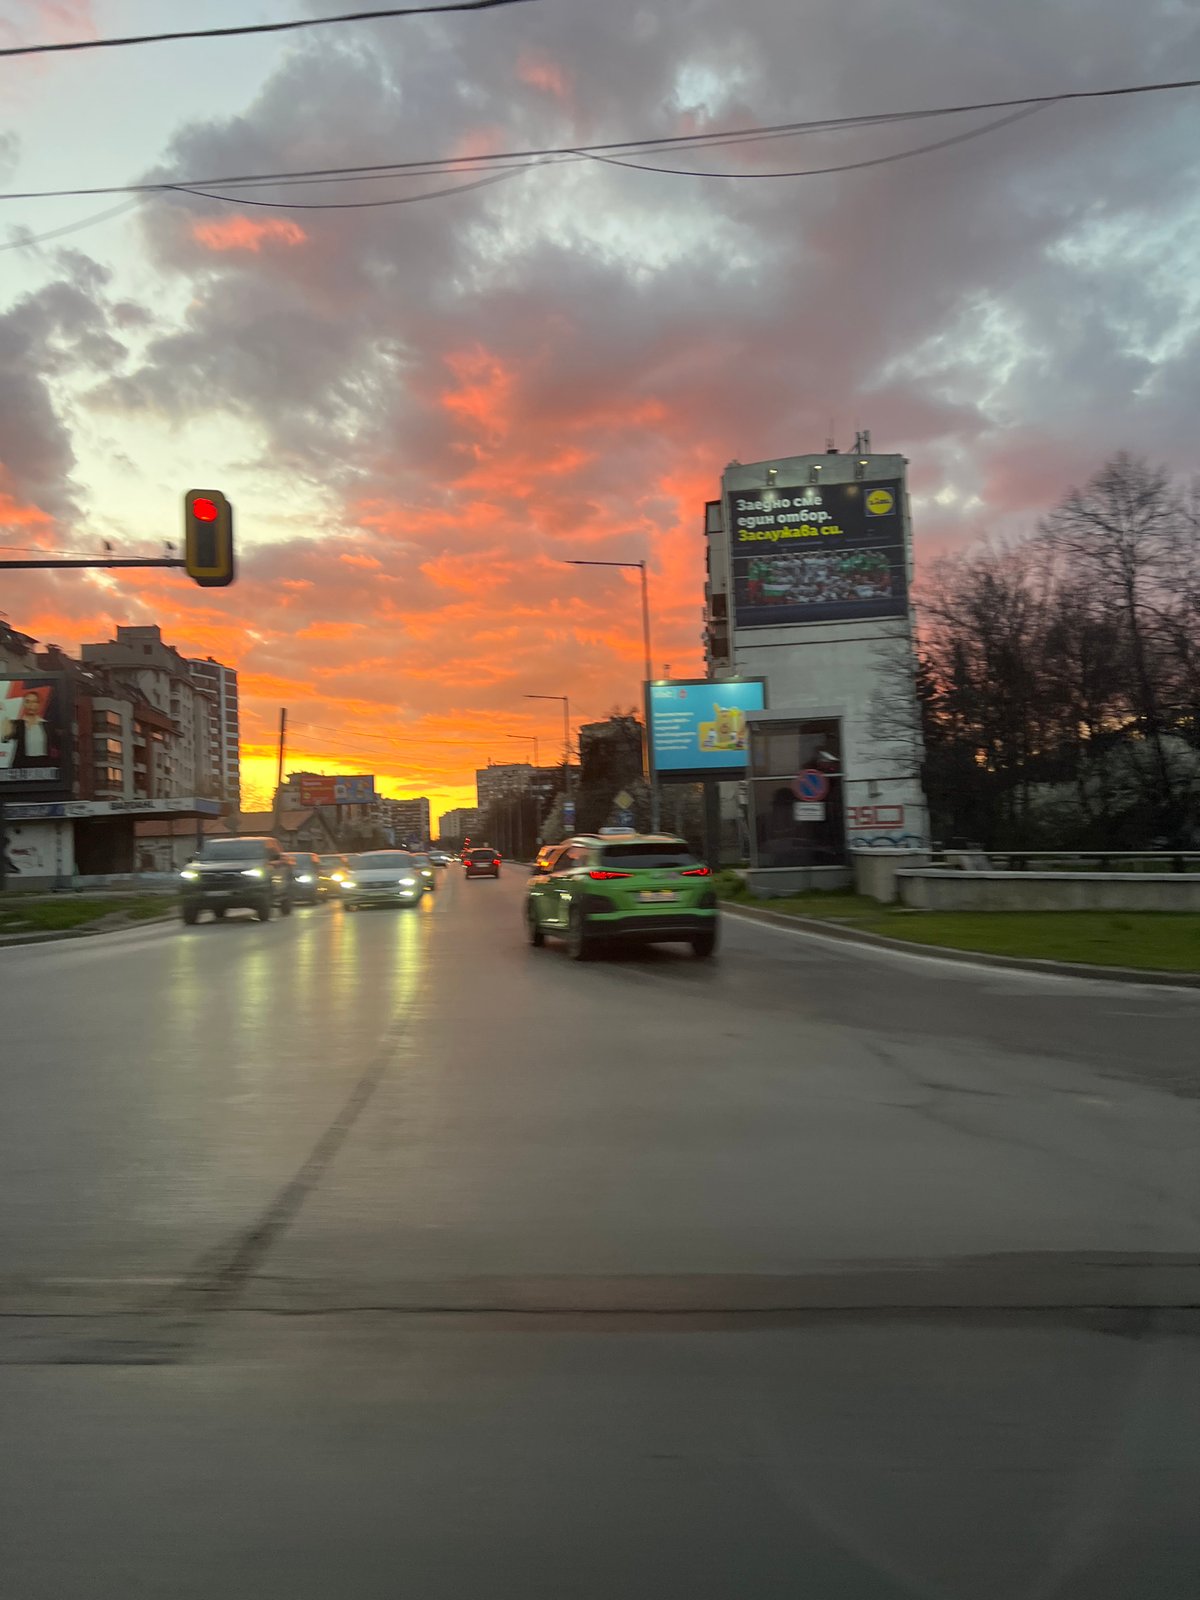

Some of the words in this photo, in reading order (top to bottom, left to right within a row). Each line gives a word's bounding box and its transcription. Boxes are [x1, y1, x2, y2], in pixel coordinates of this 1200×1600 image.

[736, 498, 791, 512] Заедно
[794, 496, 823, 507] сме
[737, 515, 775, 528] един
[777, 510, 832, 523] отбор.
[738, 525, 819, 542] Заслужава
[820, 525, 843, 536] си.
